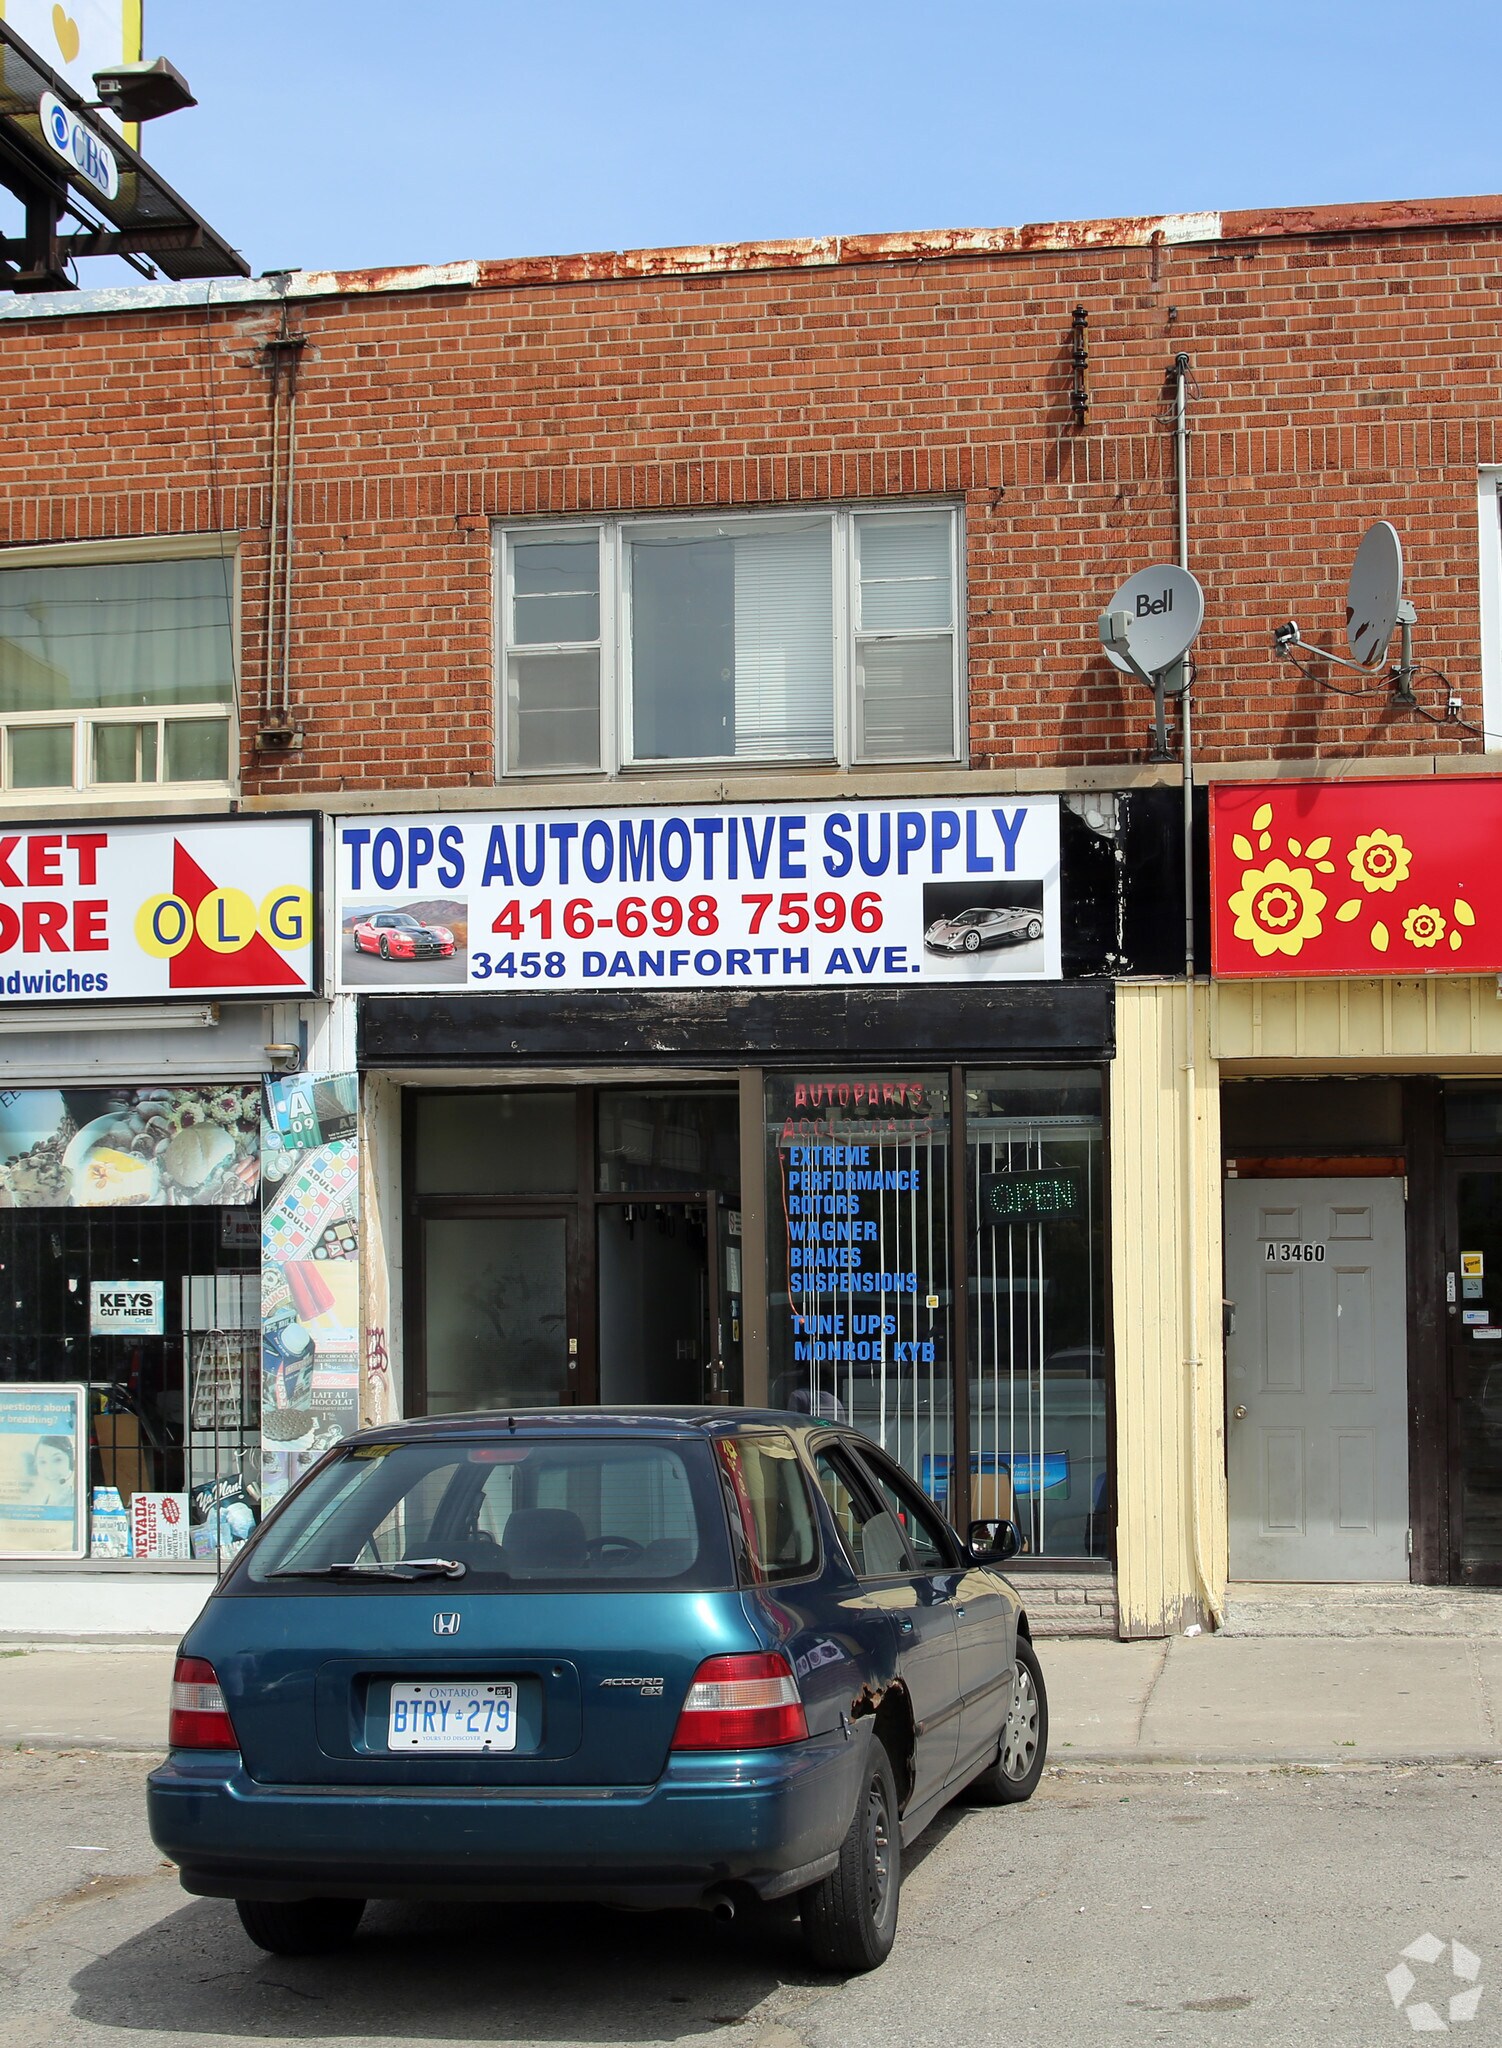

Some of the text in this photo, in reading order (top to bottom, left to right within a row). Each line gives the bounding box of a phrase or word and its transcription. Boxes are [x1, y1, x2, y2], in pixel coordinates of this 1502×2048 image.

[72, 124, 109, 189] CBS
[1135, 589, 1173, 618] Bell
[342, 808, 1028, 890] TOPS AUTOMOTIVE SUPPLY
[491, 891, 883, 940] 416-698 7596
[471, 946, 921, 979] 3458 DANFORTH AVE.
[290, 1091, 313, 1119] A
[795, 1083, 924, 1108] AUTOPARTS
[292, 1118, 314, 1132] 09
[790, 1146, 870, 1166] EXTREME
[306, 1168, 336, 1195] ADULT
[789, 1170, 920, 1191] PERFORMANCE
[789, 1194, 860, 1215] ROTORS
[990, 1180, 1077, 1213] OPEN
[280, 1206, 311, 1233] ADULT
[788, 1221, 878, 1241] WAGNER
[790, 1247, 861, 1268] BRAKES
[1267, 1244, 1325, 1262] A 3460
[790, 1273, 918, 1293] SUSPENSIONS
[100, 1293, 153, 1307] KEYS
[791, 1315, 896, 1335] TUNE UPS
[794, 1341, 935, 1362] MONROE KYB
[43, 1402, 71, 1412] about
[135, 1496, 148, 1559] NEVADA
[148, 1503, 157, 1551] TICKETS
[600, 1678, 664, 1686] ACCORD
[641, 1687, 664, 1696] EX
[429, 1688, 479, 1699] ONTARIO
[394, 1700, 510, 1732] BTRY 279
